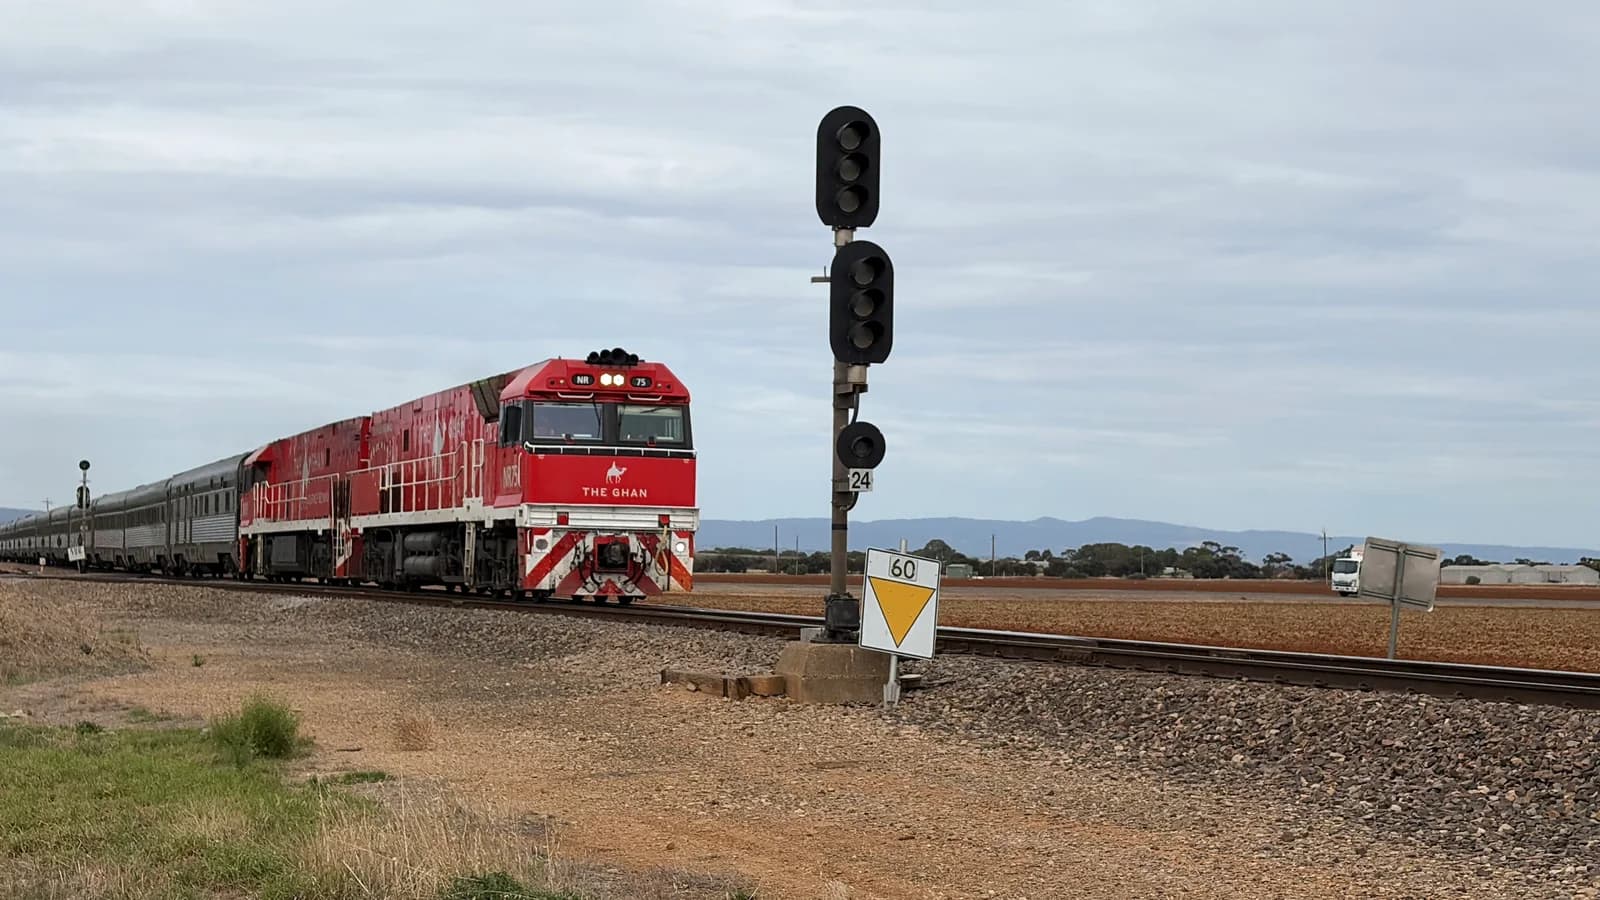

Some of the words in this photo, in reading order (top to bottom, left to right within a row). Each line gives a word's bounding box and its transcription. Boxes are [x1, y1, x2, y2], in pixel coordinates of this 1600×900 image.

[576, 375, 589, 385] NR
[636, 378, 646, 387] 75
[851, 471, 871, 489] 24
[582, 487, 607, 497] THE
[612, 488, 648, 498] GHAN
[891, 558, 916, 579] 60
